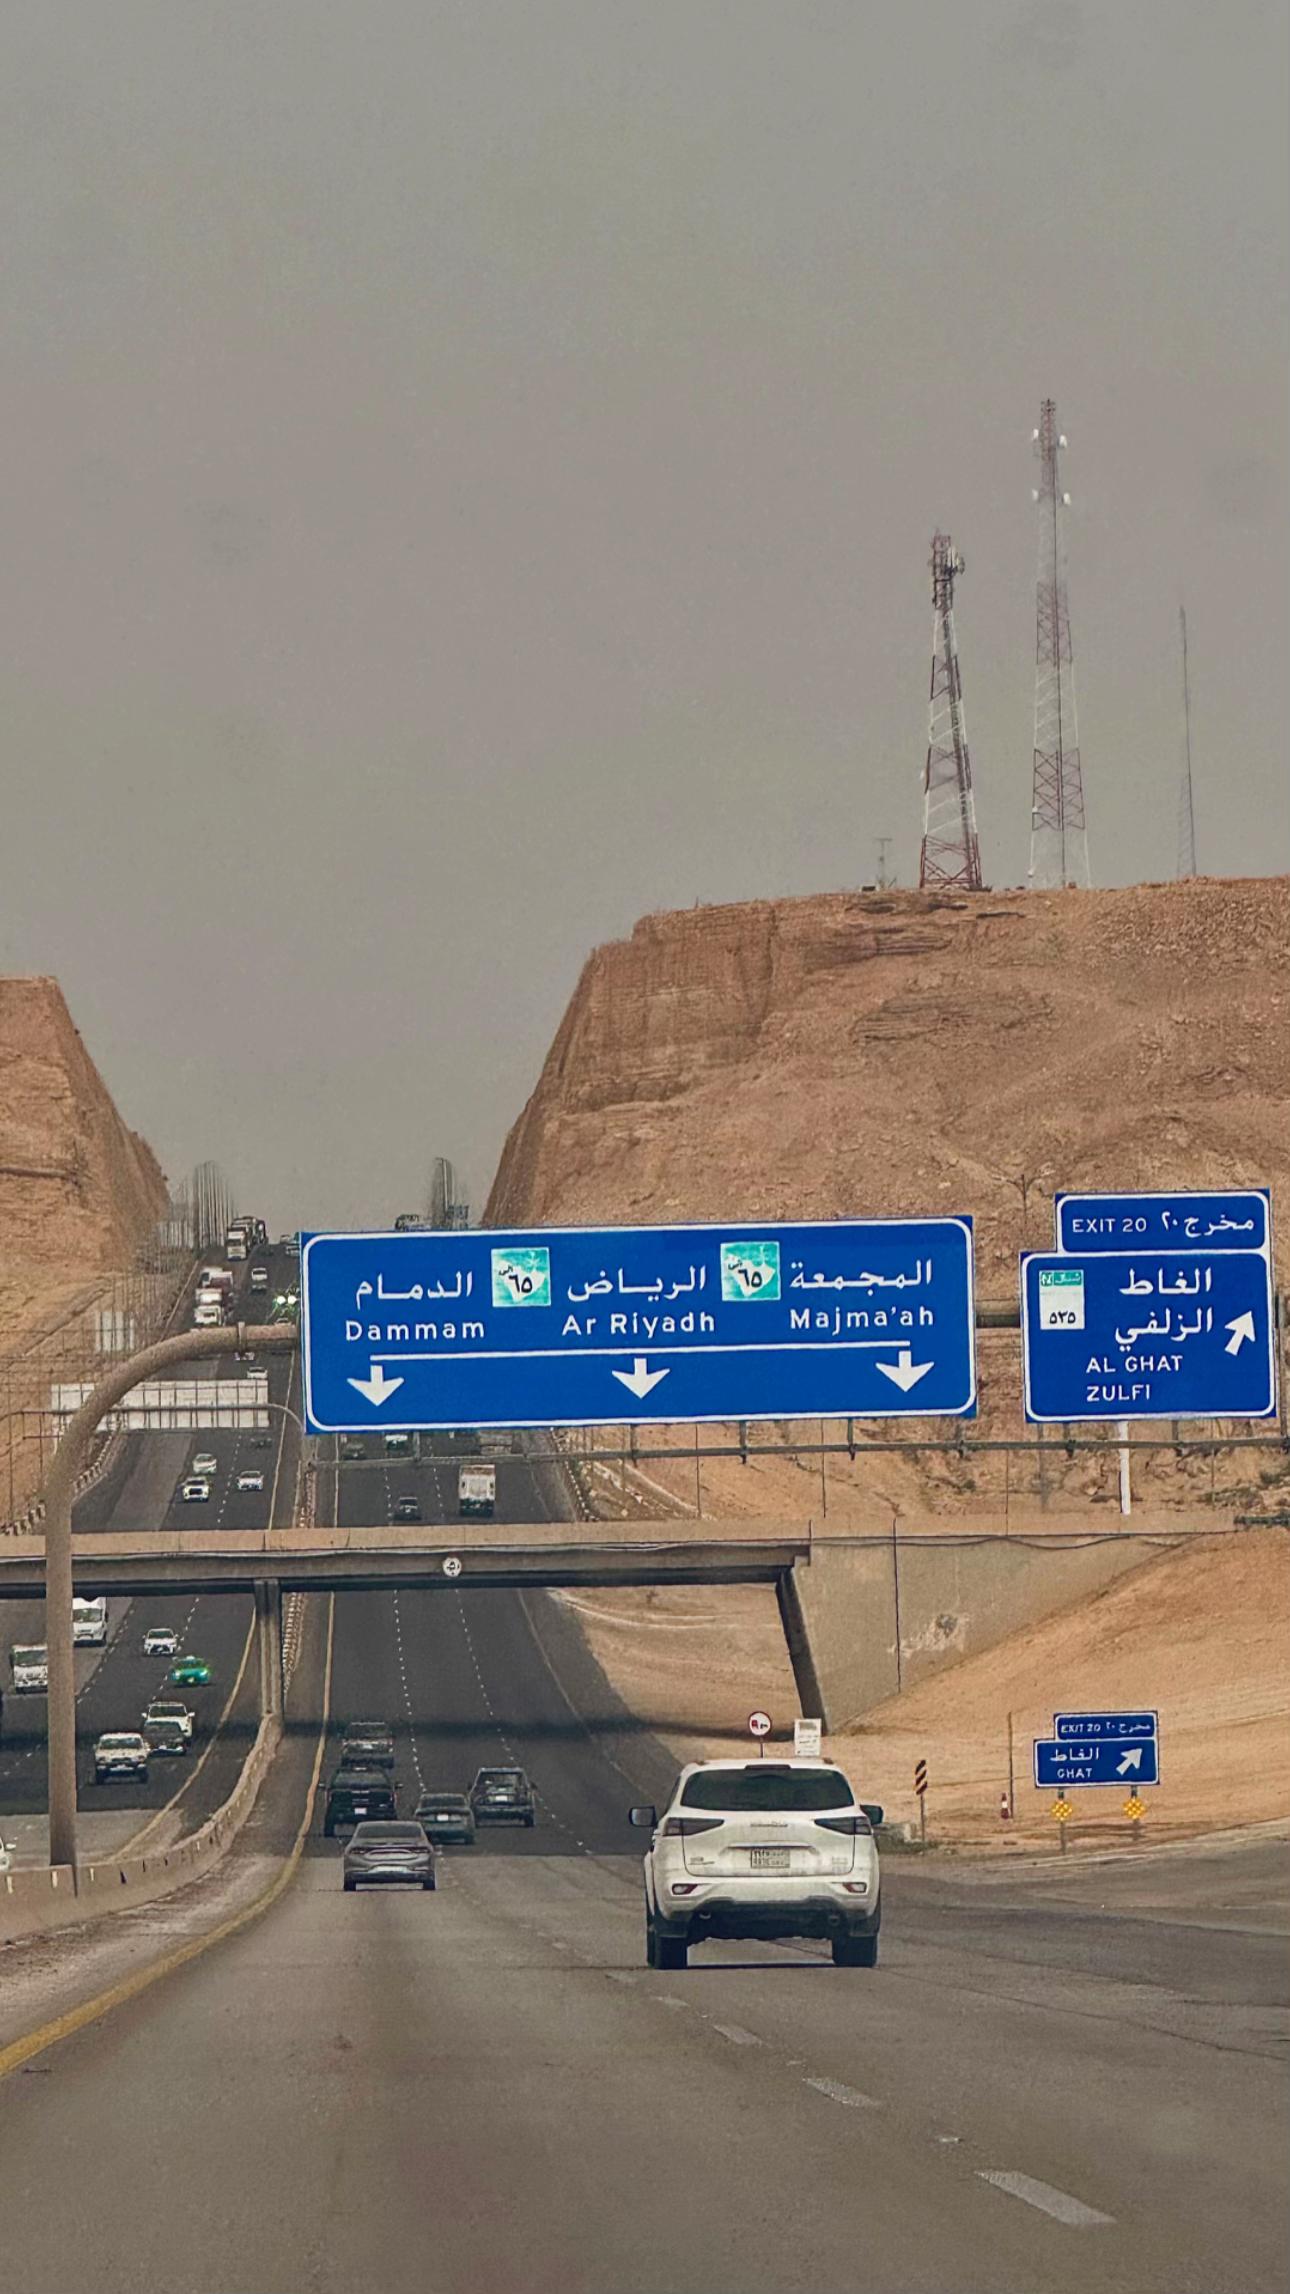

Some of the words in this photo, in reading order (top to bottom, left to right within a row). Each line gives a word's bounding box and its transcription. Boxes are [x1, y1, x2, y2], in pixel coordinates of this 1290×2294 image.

[1072, 1218, 1115, 1233] EXIT
[1122, 1217, 1147, 1232] 20
[1161, 1211, 1178, 1229] ٢٠
[1184, 1213, 1254, 1238] مخرج
[508, 1274, 533, 1294] ٦٥
[567, 1266, 706, 1302] الرياض
[737, 1268, 763, 1288] ٦٥
[790, 1259, 932, 1296] المجمعة
[1119, 1267, 1212, 1295] الغاط
[356, 1271, 473, 1309] الدمام
[345, 1320, 485, 1341] Dammam
[562, 1315, 597, 1336] Ar
[610, 1311, 715, 1339] Riyadh
[790, 1306, 934, 1335] Majma'ah
[1115, 1307, 1213, 1352] الزلفي
[1086, 1357, 1116, 1373] AL
[1125, 1355, 1183, 1373] GHAT
[1086, 1384, 1150, 1402] ZULFI
[1050, 1747, 1099, 1762] الغاط
